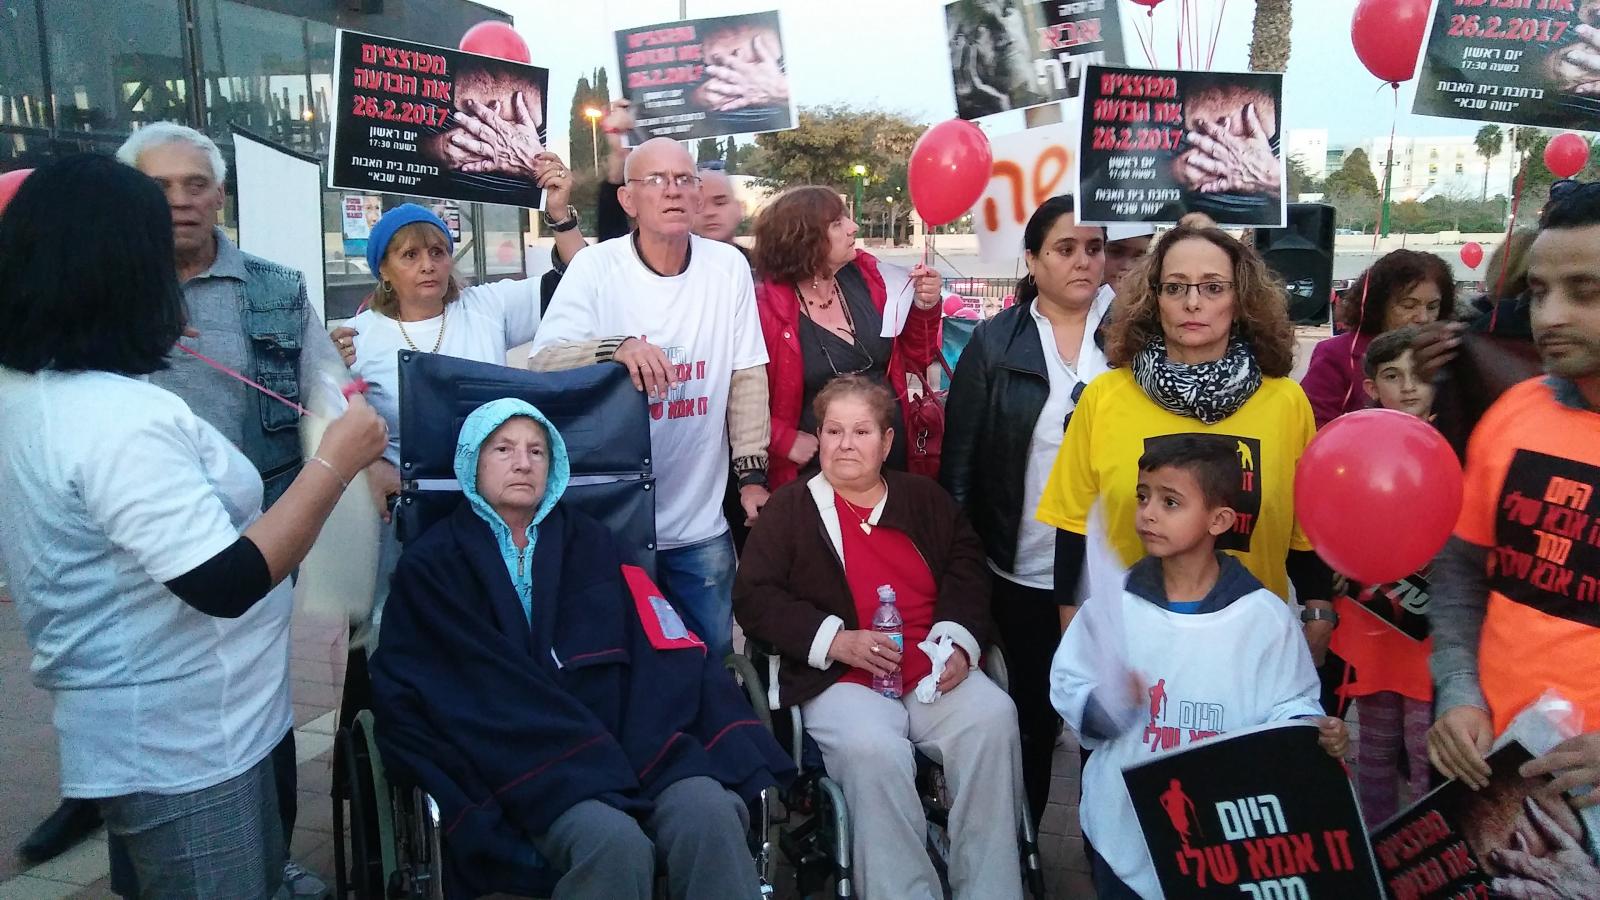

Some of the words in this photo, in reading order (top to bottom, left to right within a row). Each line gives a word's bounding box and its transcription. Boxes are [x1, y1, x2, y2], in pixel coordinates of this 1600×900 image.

[1447, 14, 1570, 42] 26.2.2017
[361, 44, 447, 75] מפוצצים
[1463, 46, 1499, 59] ראשון
[1504, 49, 1523, 60] יום
[1461, 60, 1487, 70] 17:30
[1490, 64, 1520, 73] בשעה
[353, 68, 417, 95] הבועה
[422, 80, 451, 101] את
[1100, 73, 1177, 98] מפוצצים
[1436, 81, 1475, 93] האבות
[1478, 84, 1499, 96] בית
[1502, 86, 1544, 100] ברחבת
[352, 95, 449, 127] 26.2.2017
[1093, 99, 1150, 123] הבועה
[1154, 103, 1183, 124] את
[369, 126, 399, 139] ראשון
[403, 130, 418, 141] יום
[1092, 126, 1183, 151] 26.2.2017
[368, 139, 391, 148] 17:30
[393, 142, 417, 151] בשעה
[351, 156, 382, 168] האבות
[387, 161, 403, 171] בית
[406, 164, 439, 175] ברחבת
[1141, 157, 1155, 168] יום
[668, 398, 694, 419] אמא
[698, 397, 708, 415] זו
[1543, 475, 1594, 511] היום
[1542, 504, 1589, 540] אבא
[1533, 529, 1573, 565] מחר
[1529, 558, 1574, 596] אבא
[1179, 700, 1224, 731] היום
[1215, 794, 1288, 841] היום
[1323, 829, 1355, 871] זו
[1375, 810, 1451, 870] מפוצצים
[1176, 842, 1239, 888] שלי
[1243, 832, 1320, 880] אמא
[1440, 841, 1477, 879] את
